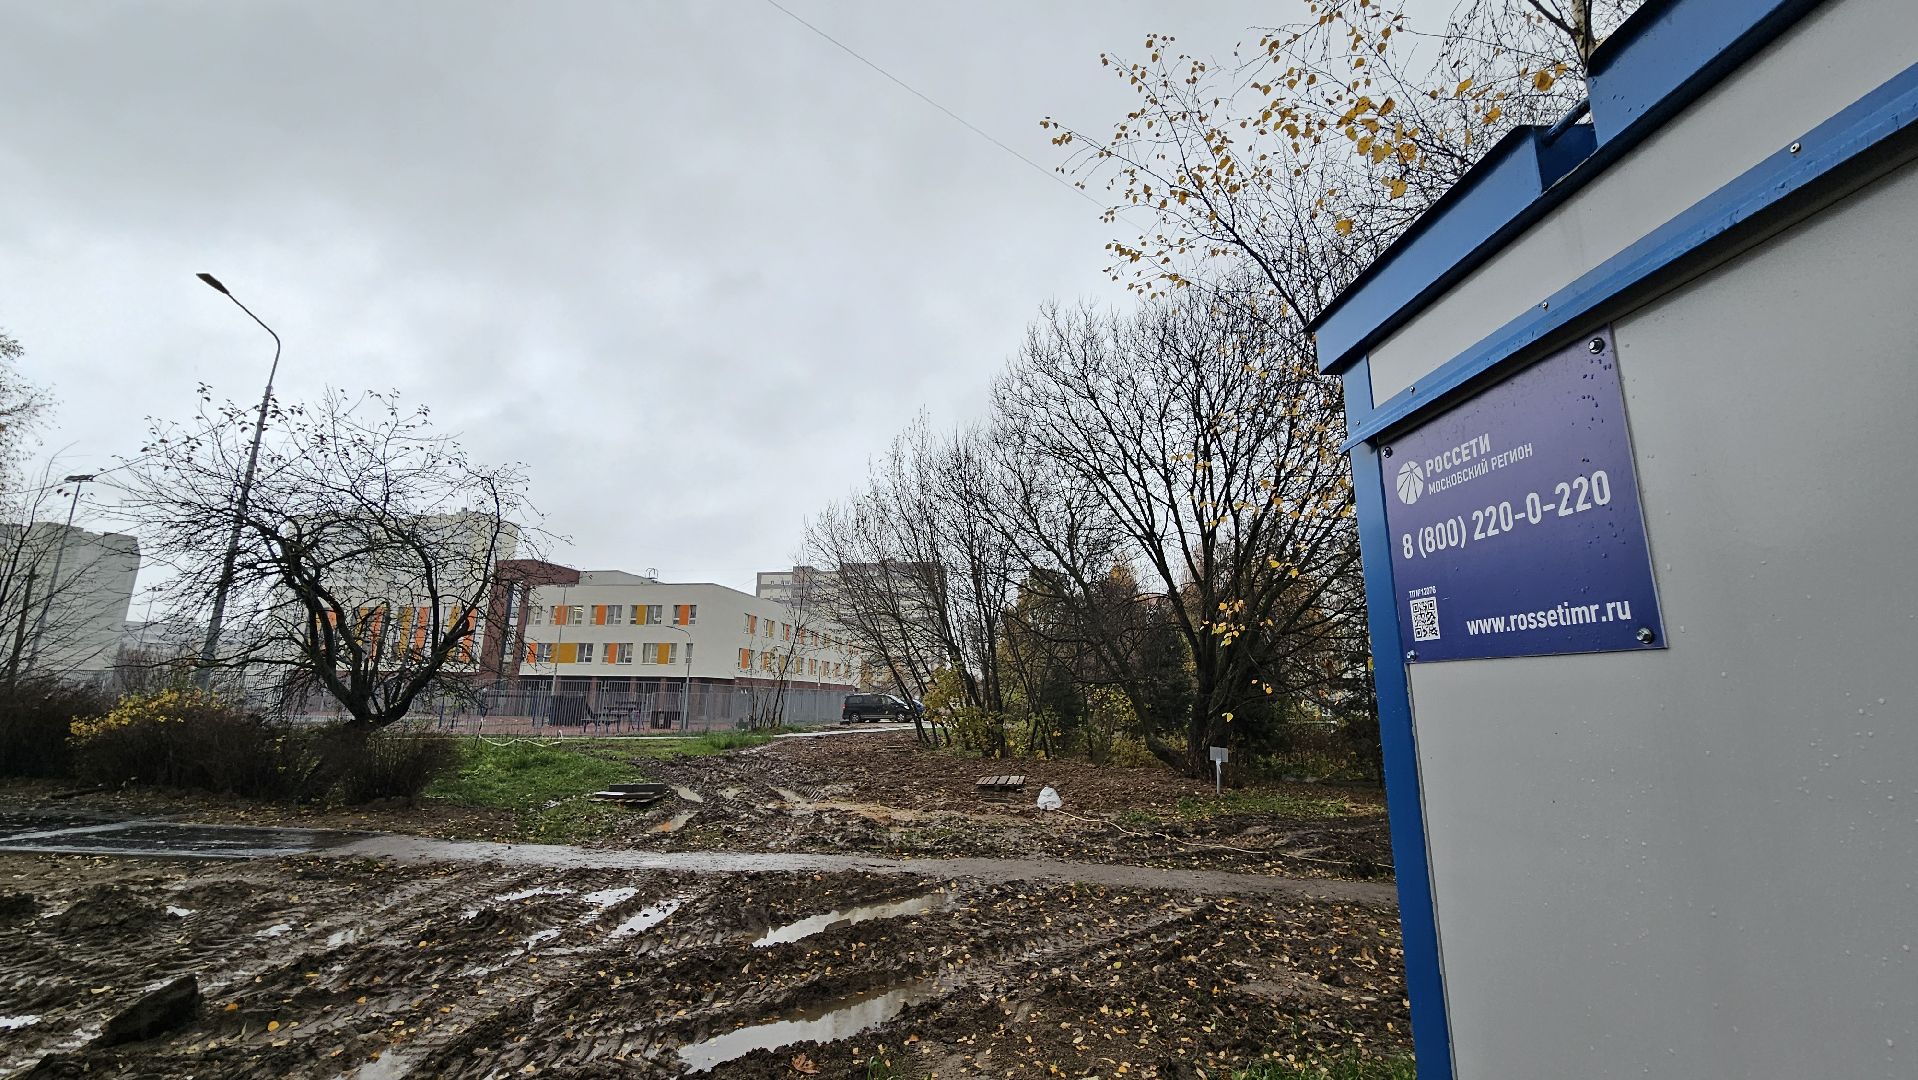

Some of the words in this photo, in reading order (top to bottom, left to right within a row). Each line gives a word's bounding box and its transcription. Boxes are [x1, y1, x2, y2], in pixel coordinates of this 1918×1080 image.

[1425, 433, 1491, 477] РОССЕТИ
[1428, 458, 1489, 495] МОСКОВСКИЙ
[1491, 443, 1533, 470] РЕГИОН
[1402, 534, 1414, 559] 8
[1418, 516, 1466, 558] (800)
[1472, 470, 1611, 540] 220-0-220
[1467, 601, 1631, 635] www.rossetimr.ru
